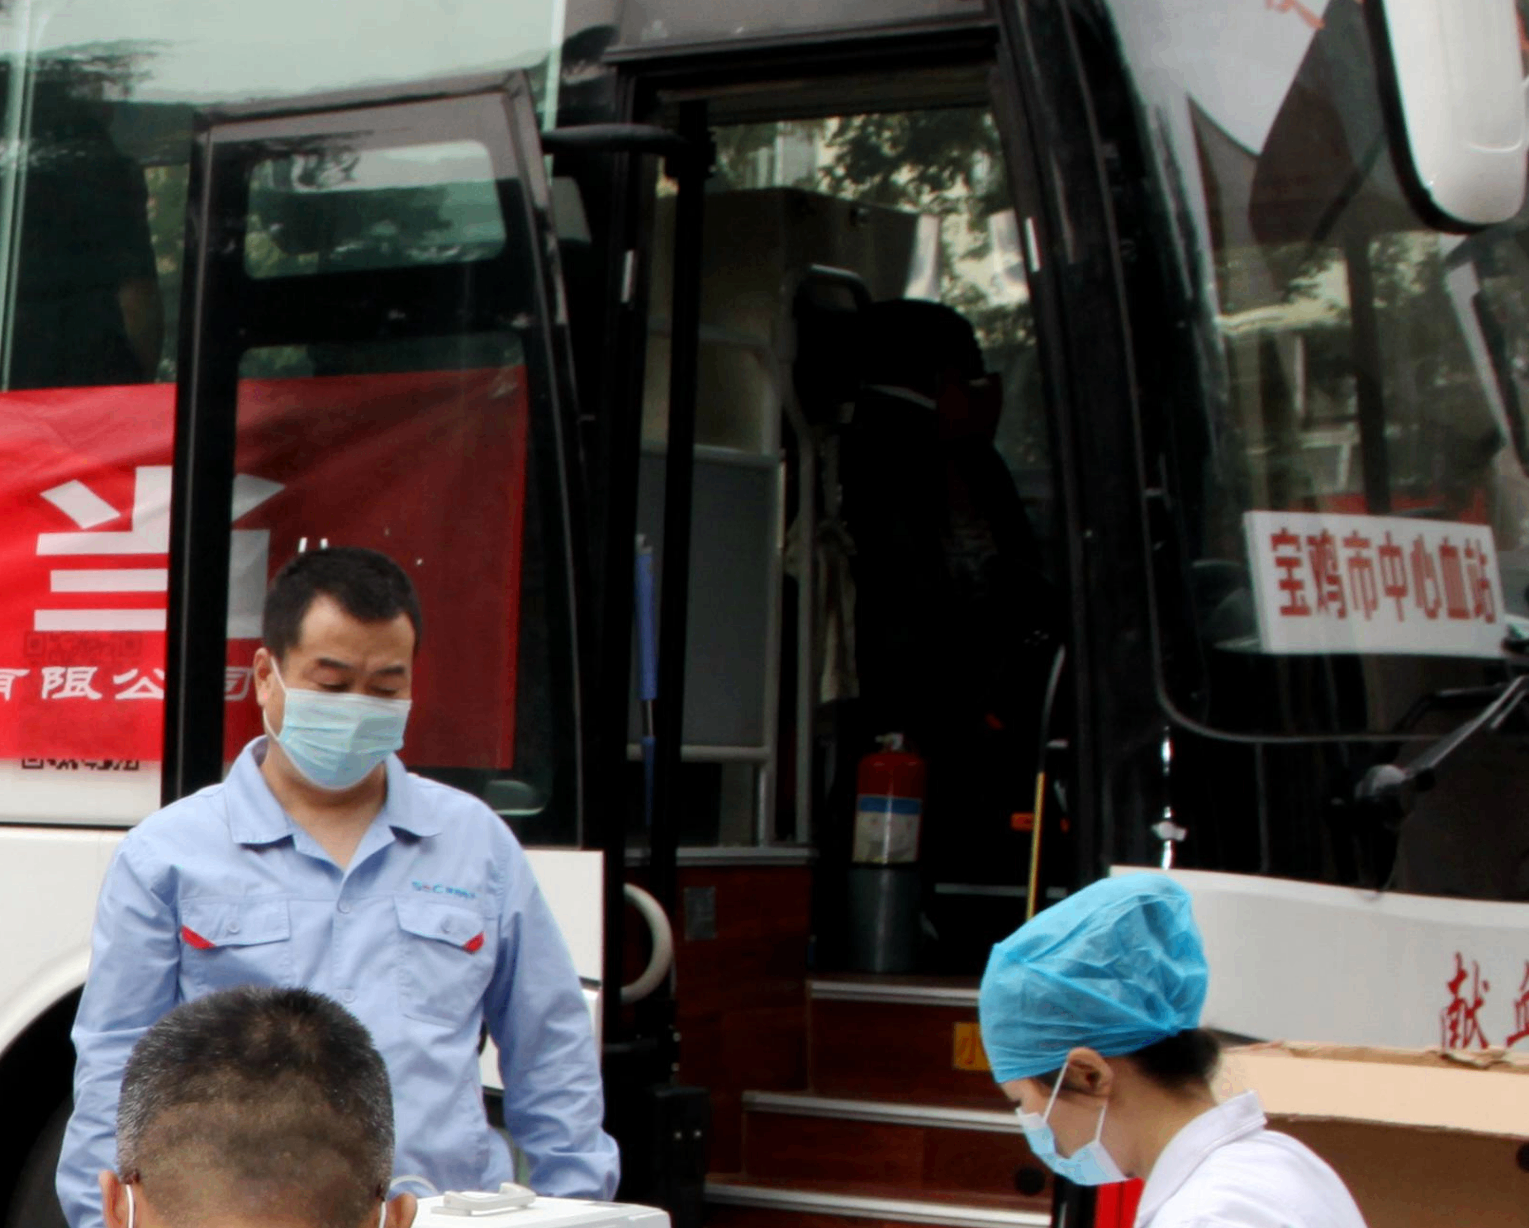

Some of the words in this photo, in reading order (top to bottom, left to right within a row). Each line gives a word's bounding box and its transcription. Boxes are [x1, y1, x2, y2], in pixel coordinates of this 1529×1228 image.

[1270, 527, 1497, 624] 宝鸡市中心血站
